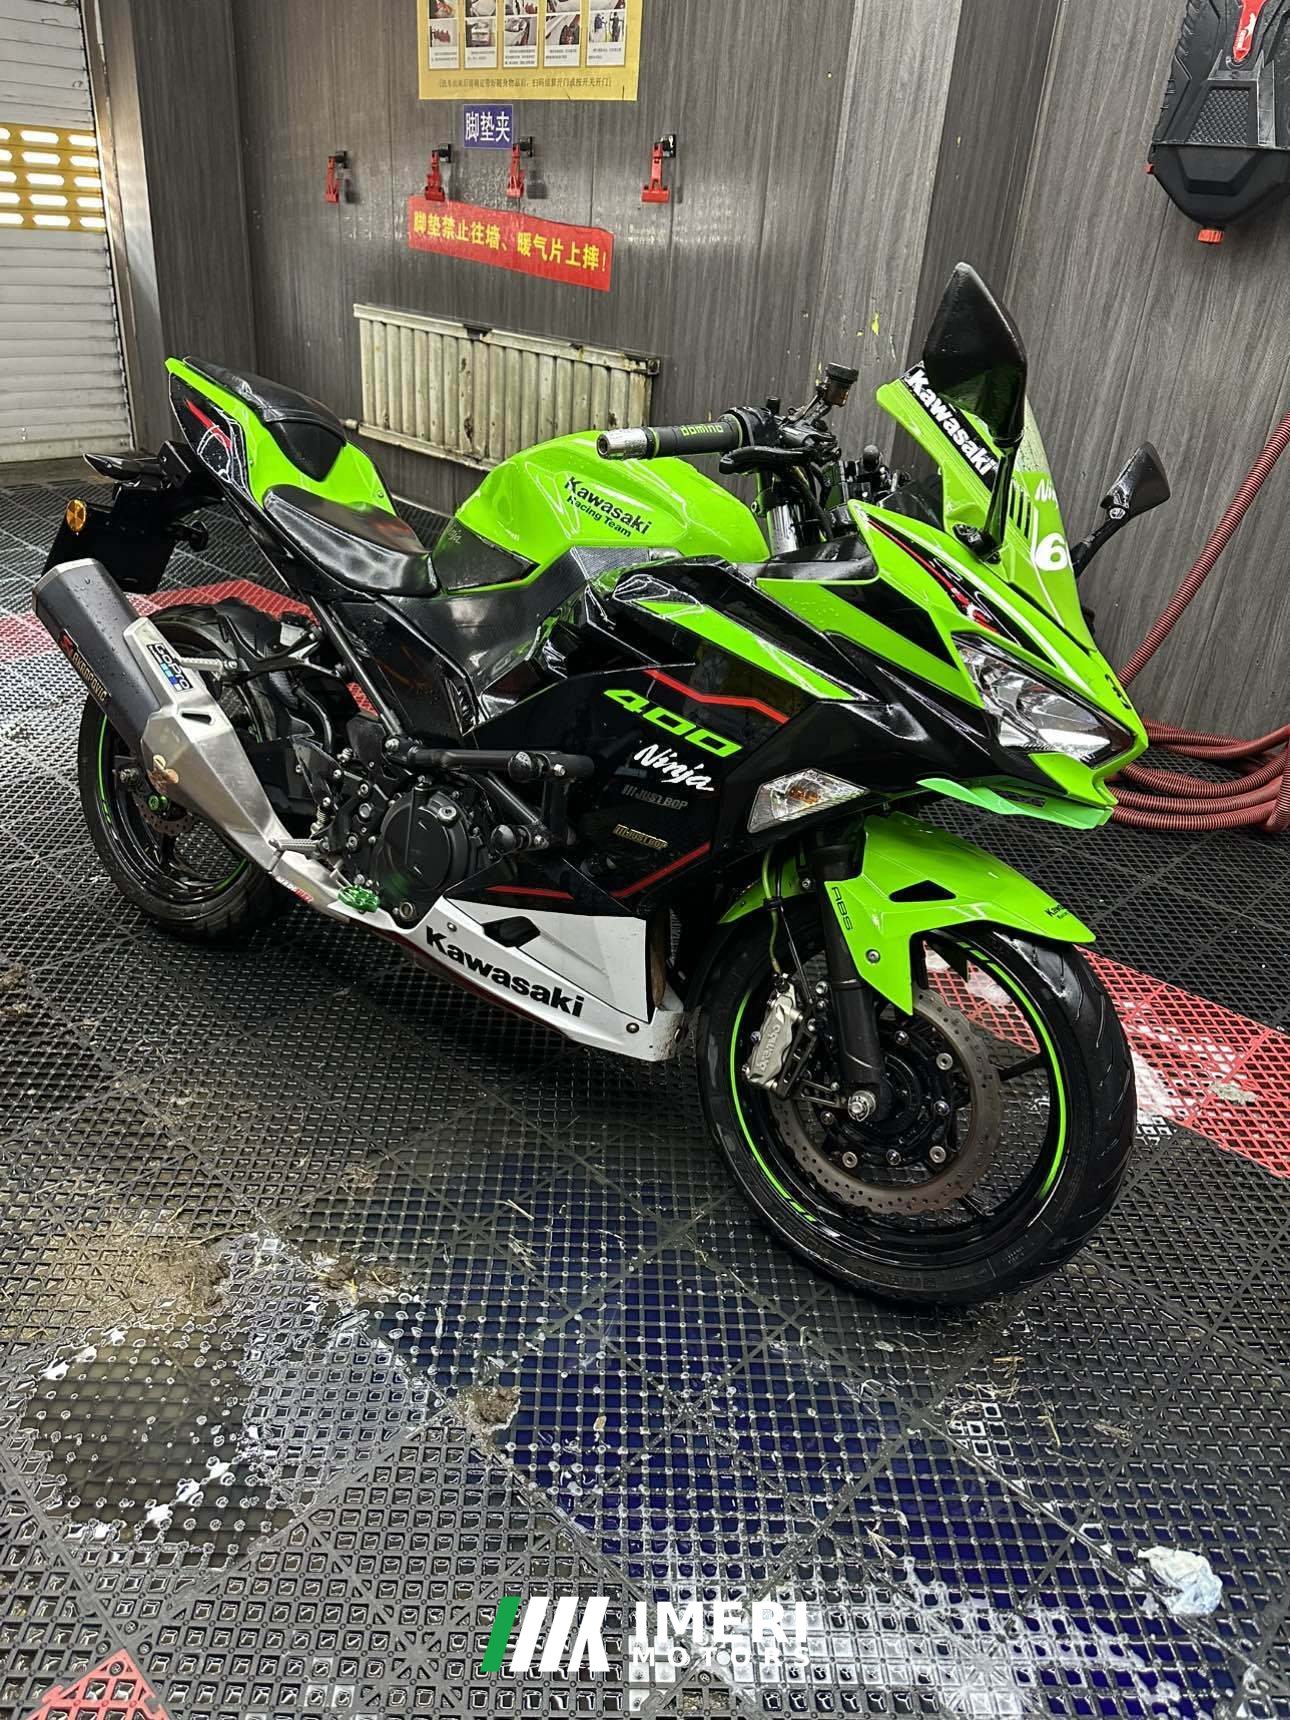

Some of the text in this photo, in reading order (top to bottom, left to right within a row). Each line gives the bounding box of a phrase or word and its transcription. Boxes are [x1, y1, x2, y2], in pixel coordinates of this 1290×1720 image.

[465, 111, 510, 143] 脚垫夹
[680, 424, 724, 437] domino
[904, 369, 999, 476] Kawasaki
[564, 476, 652, 534] Kawasaki
[567, 495, 632, 537] Racing Team
[1033, 532, 1069, 572] 6
[154, 643, 191, 690] GoPro
[603, 689, 743, 758] 400
[633, 743, 715, 792] Ninja
[831, 886, 854, 931] ABS
[426, 925, 585, 1018] Kawasaki
